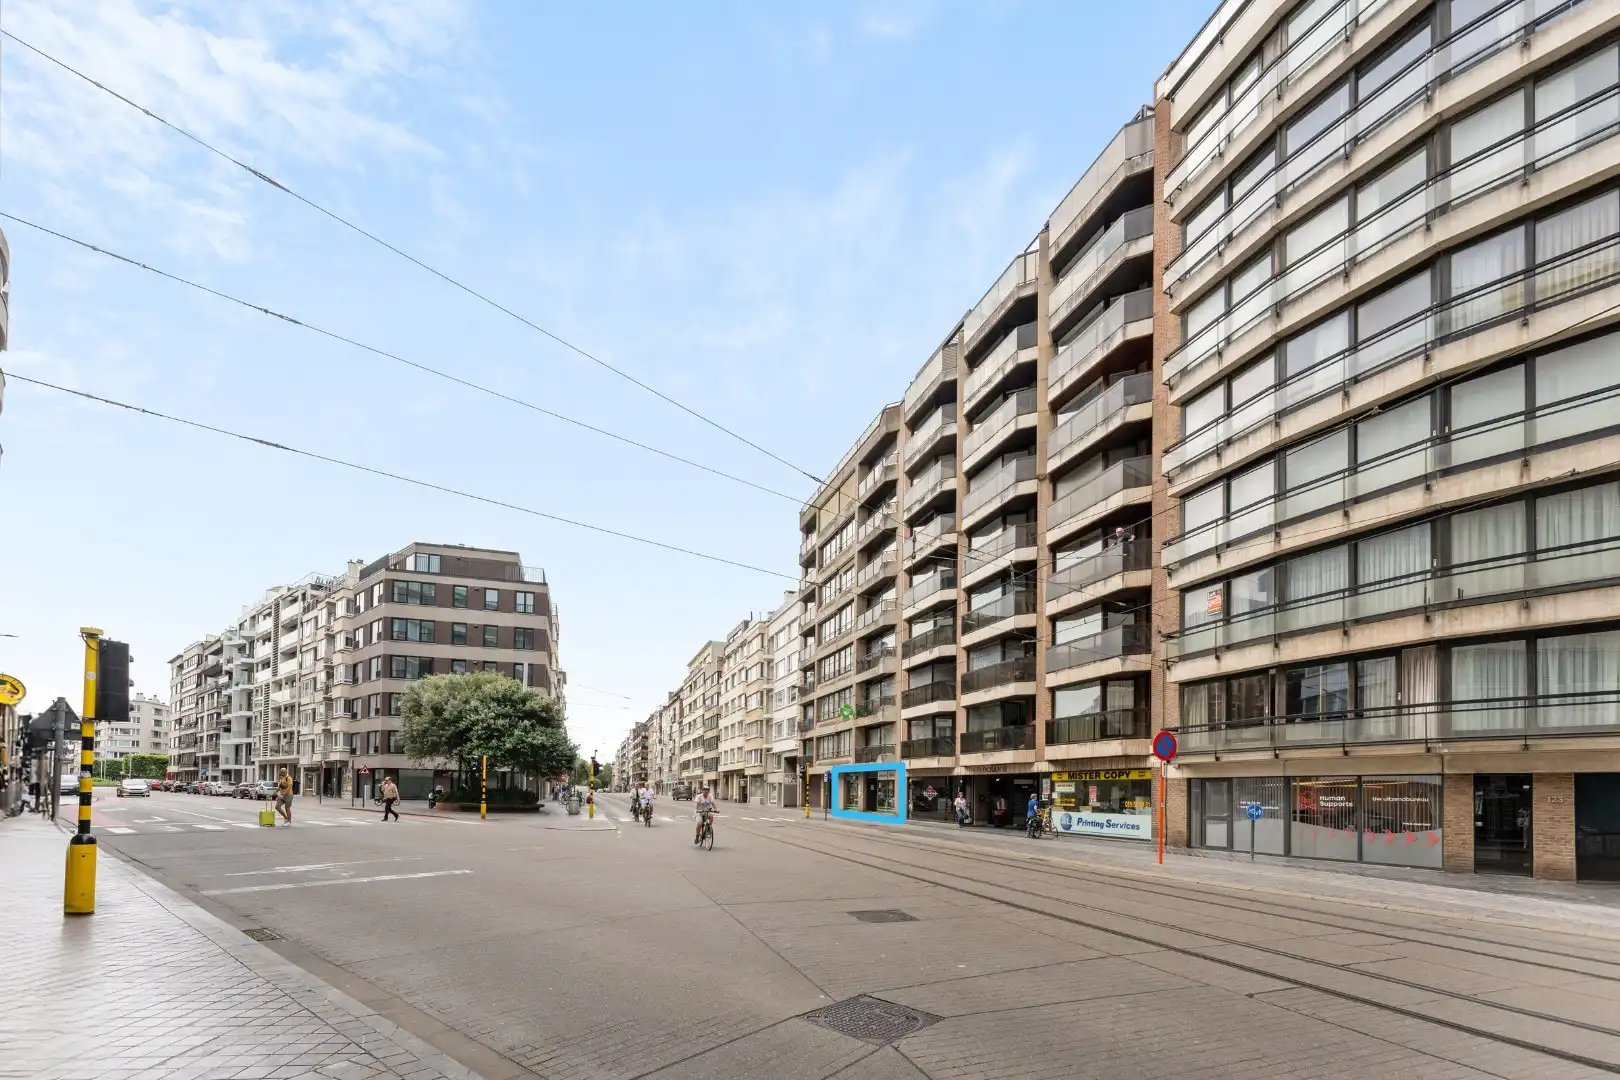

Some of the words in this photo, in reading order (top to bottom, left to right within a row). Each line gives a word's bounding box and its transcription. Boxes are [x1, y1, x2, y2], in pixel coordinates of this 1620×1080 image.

[1067, 771, 1101, 780] MISTER
[1103, 770, 1131, 779] COPY
[1077, 817, 1104, 829] Printing
[1105, 819, 1140, 830] Services
